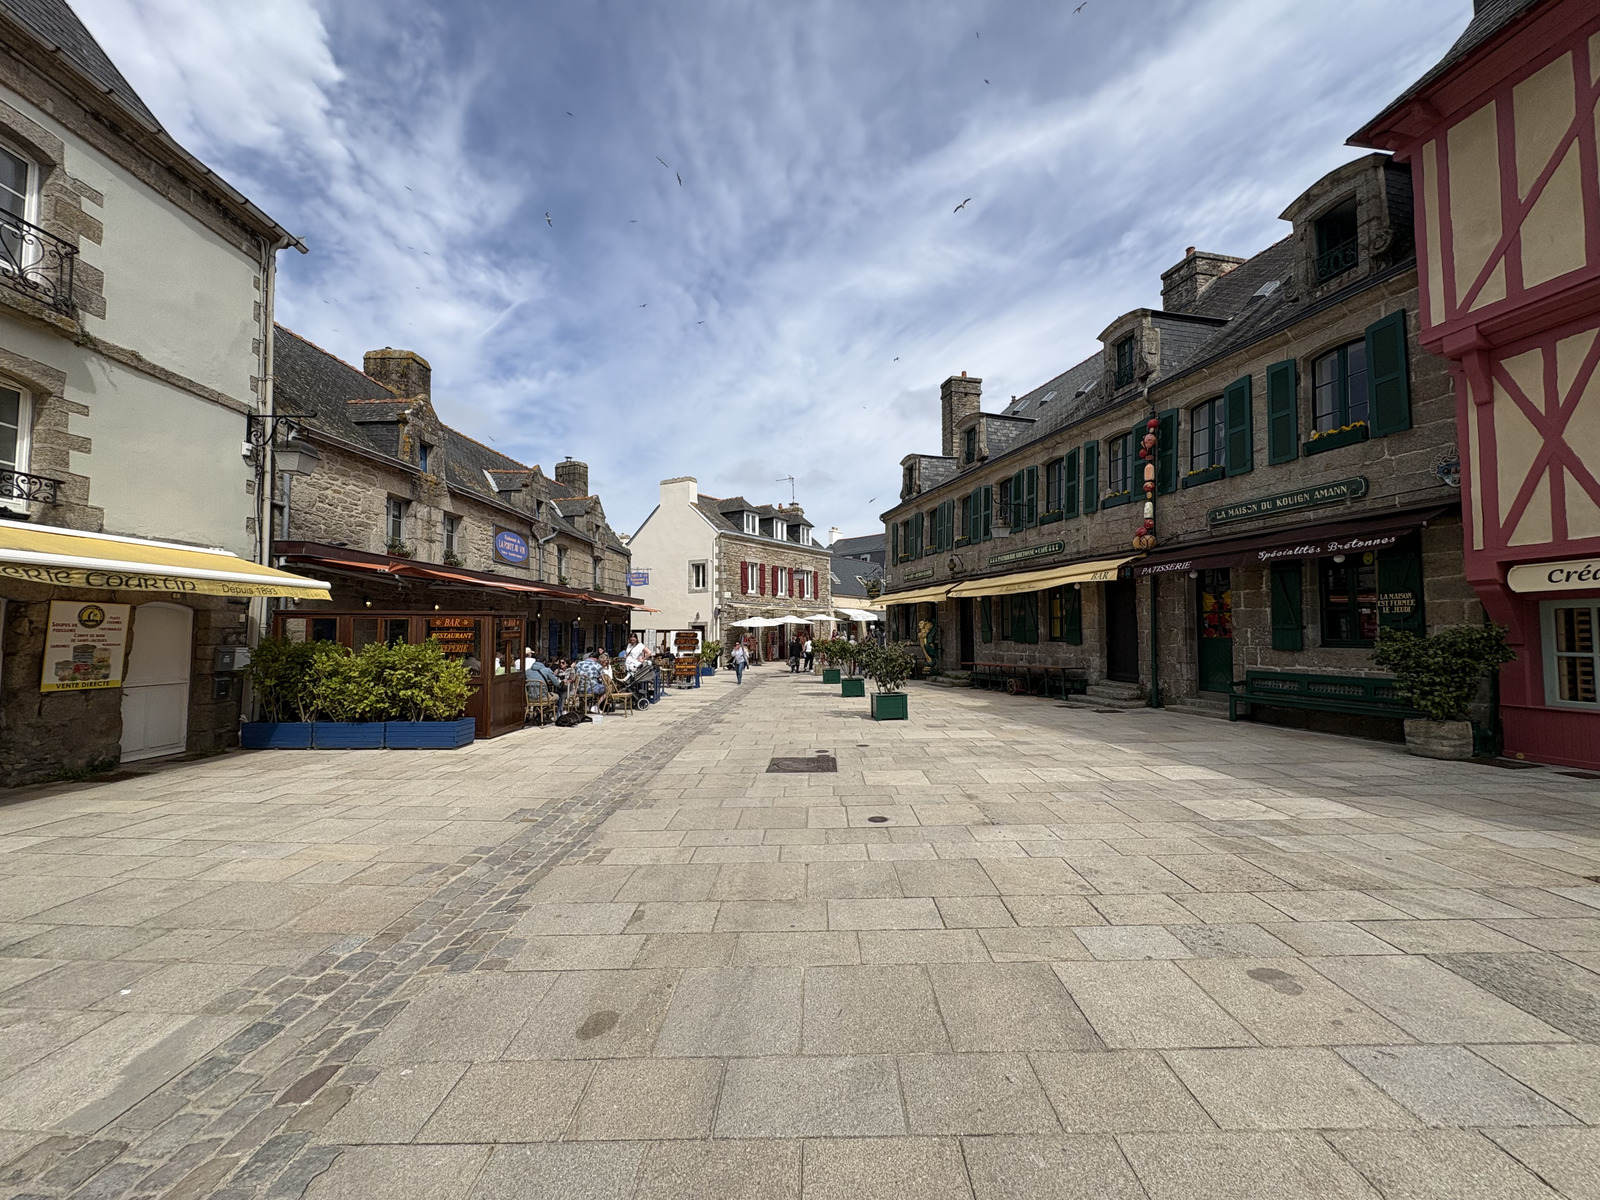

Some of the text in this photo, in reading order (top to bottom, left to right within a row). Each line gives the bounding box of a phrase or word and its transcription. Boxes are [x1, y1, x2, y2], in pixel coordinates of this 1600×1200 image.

[1215, 484, 1348, 520] LA MAISON DU KOUIGN AMANN
[1257, 545, 1321, 562] Spécialités
[1140, 560, 1193, 576] PATISSERIE
[1090, 571, 1109, 581] BAR
[221, 584, 278, 595] Depuis 1893
[444, 618, 460, 627] BAR
